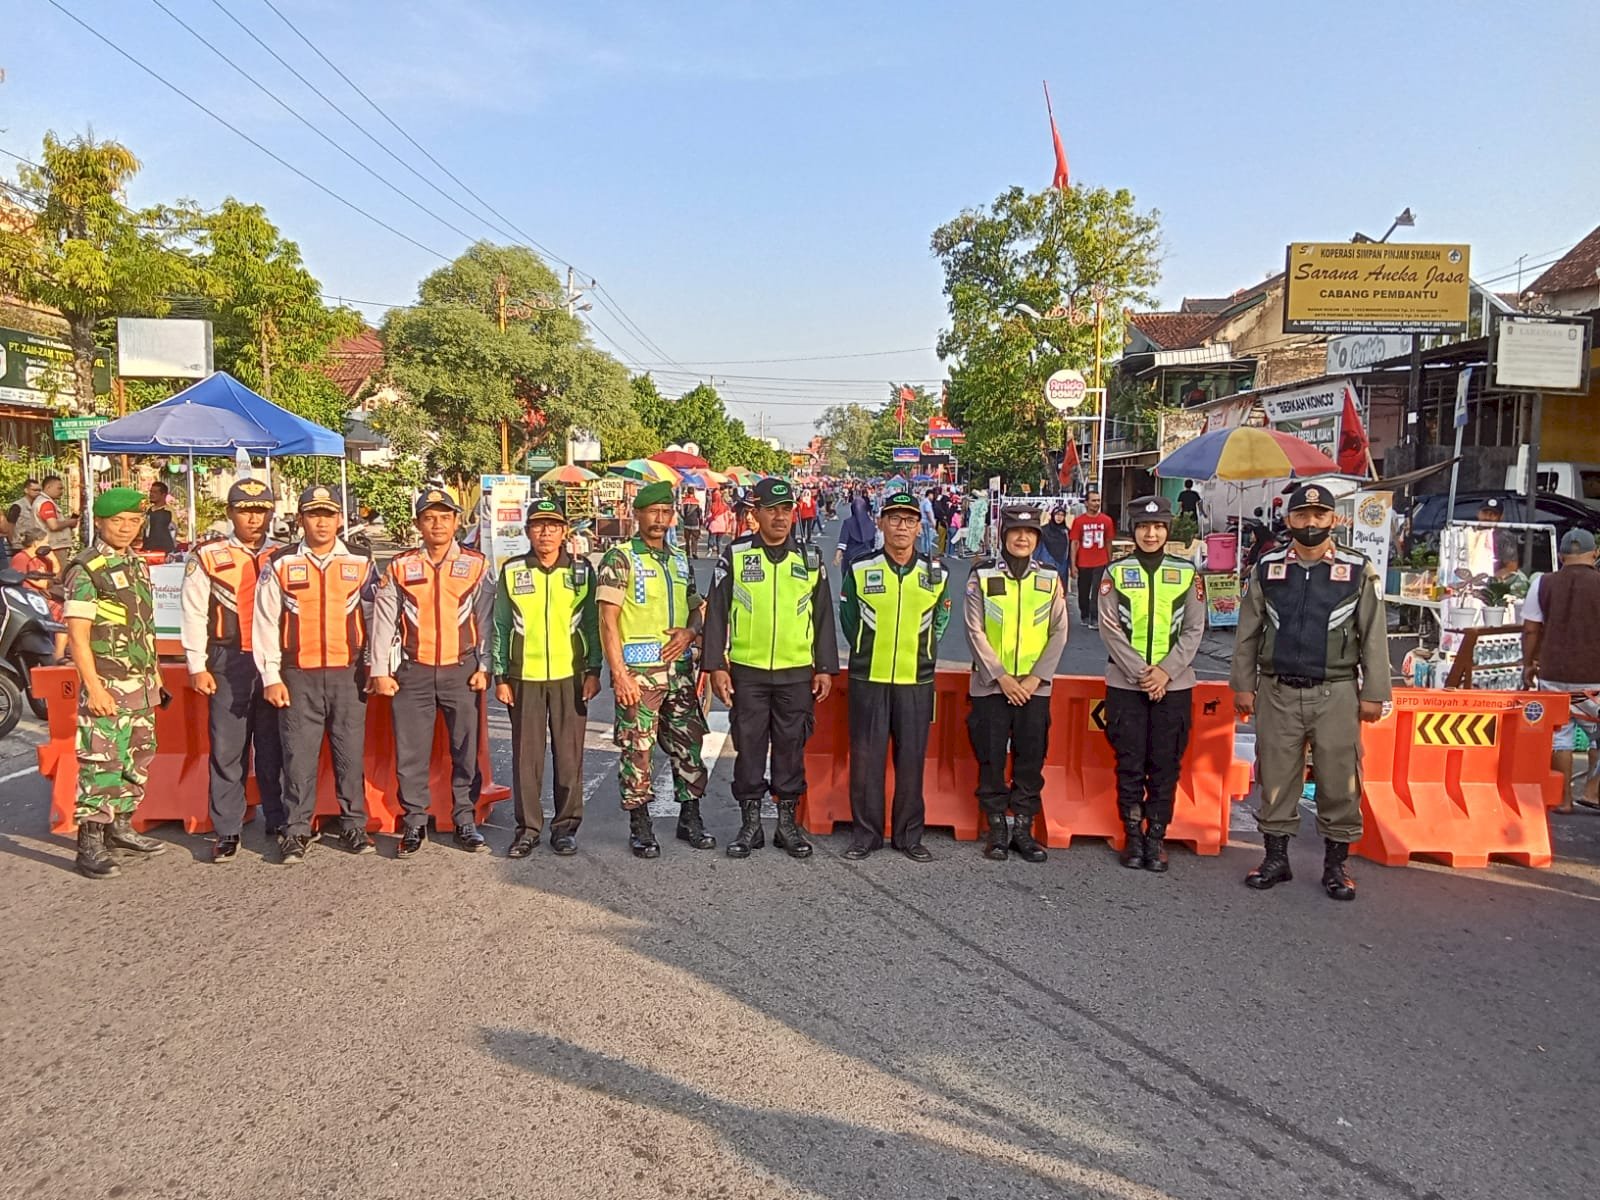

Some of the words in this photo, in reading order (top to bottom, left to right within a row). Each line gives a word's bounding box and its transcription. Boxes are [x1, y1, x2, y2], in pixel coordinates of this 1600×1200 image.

[1321, 249, 1354, 258] KOPERASI
[1356, 249, 1382, 259] SIMPAN
[1384, 250, 1409, 260] PINJAM
[1411, 250, 1440, 260] SYARIAH
[1294, 263, 1359, 281] Sarana
[1363, 264, 1418, 282] Aneka
[1423, 265, 1465, 288] Jasa
[1320, 289, 1369, 299] CABANG
[1373, 289, 1438, 299] PEMBANTU
[8, 341, 20, 352] PT.
[1082, 530, 1104, 548] 54
[745, 556, 759, 565] 24
[516, 572, 530, 580] 24
[1396, 697, 1419, 706] BPTD
[1423, 698, 1458, 708] Wilayah
